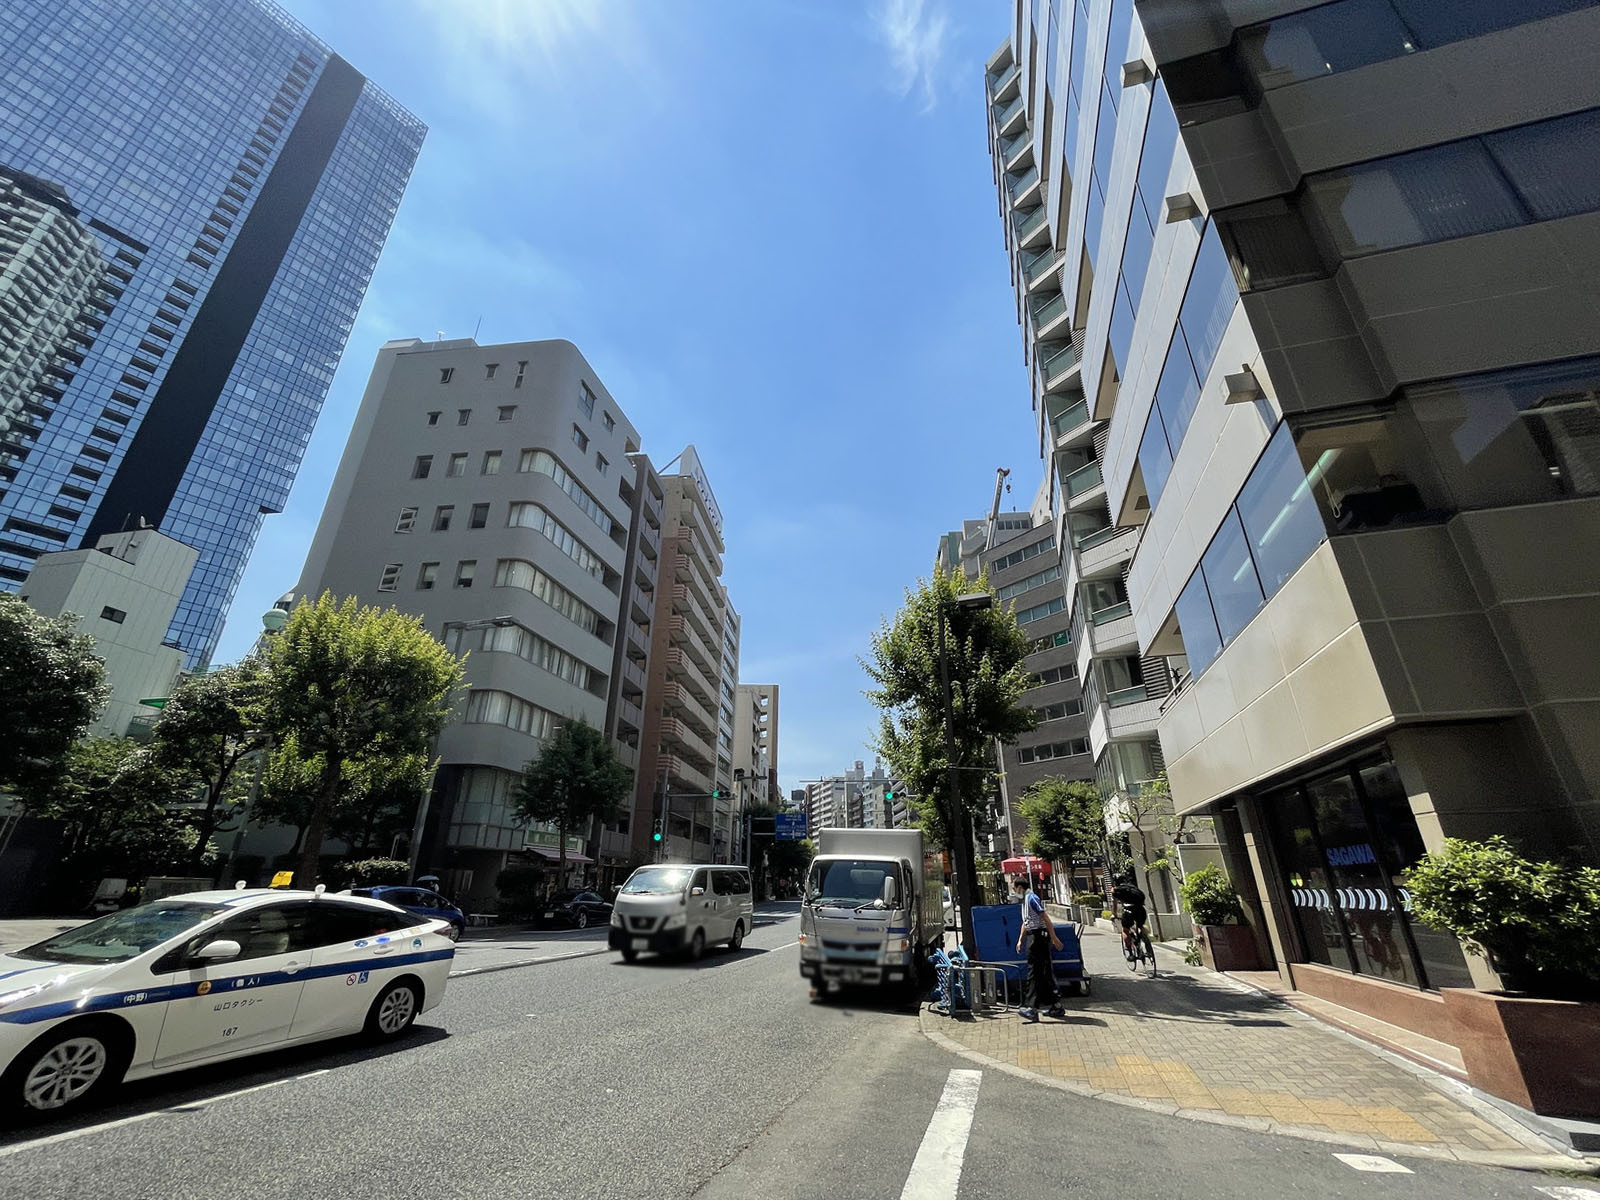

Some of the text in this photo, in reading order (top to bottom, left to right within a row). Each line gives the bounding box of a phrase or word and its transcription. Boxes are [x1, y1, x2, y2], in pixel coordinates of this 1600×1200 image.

[1326, 843, 1377, 866] SAGAWA
[213, 998, 263, 1012] 山口タクシー
[222, 1026, 238, 1037] 187
